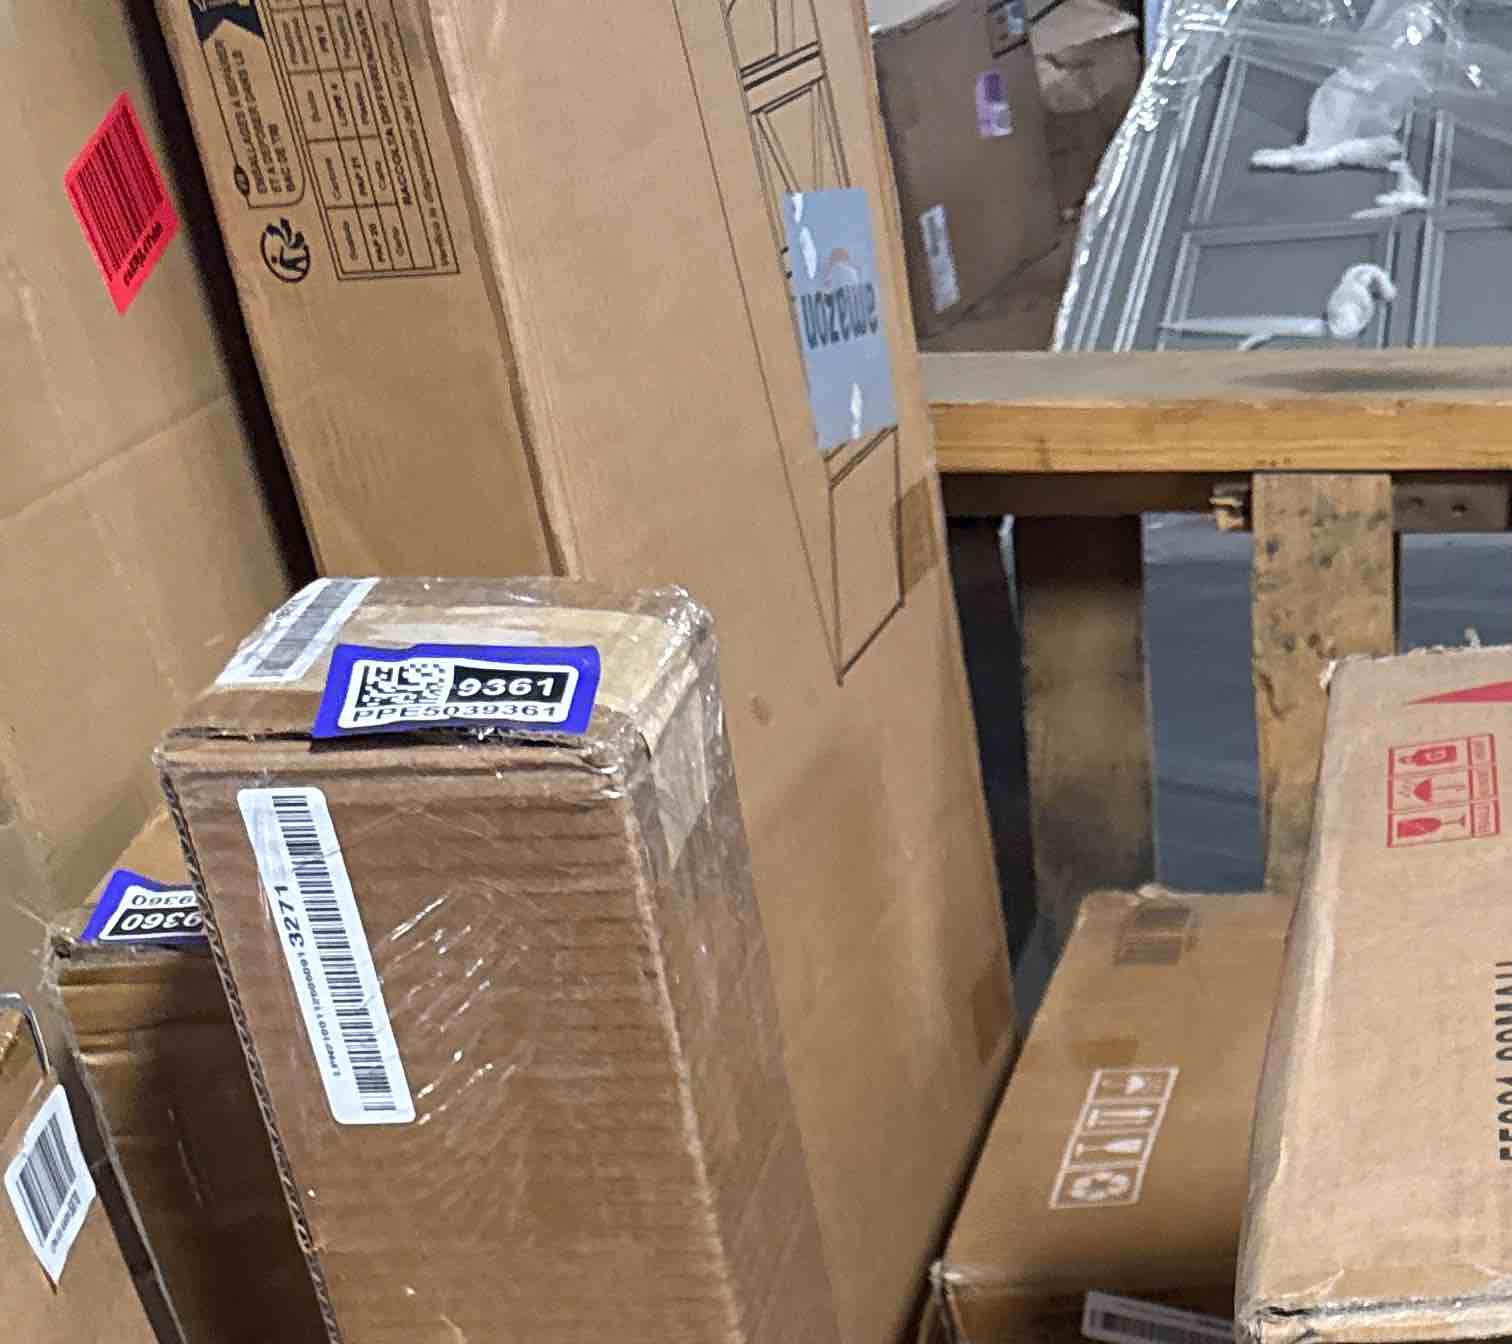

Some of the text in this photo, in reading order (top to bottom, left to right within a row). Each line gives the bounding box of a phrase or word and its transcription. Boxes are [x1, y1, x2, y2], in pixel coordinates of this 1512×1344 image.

[458, 677, 555, 698] 9361
[353, 705, 556, 722] PPE5039361
[273, 885, 306, 948] 3271
